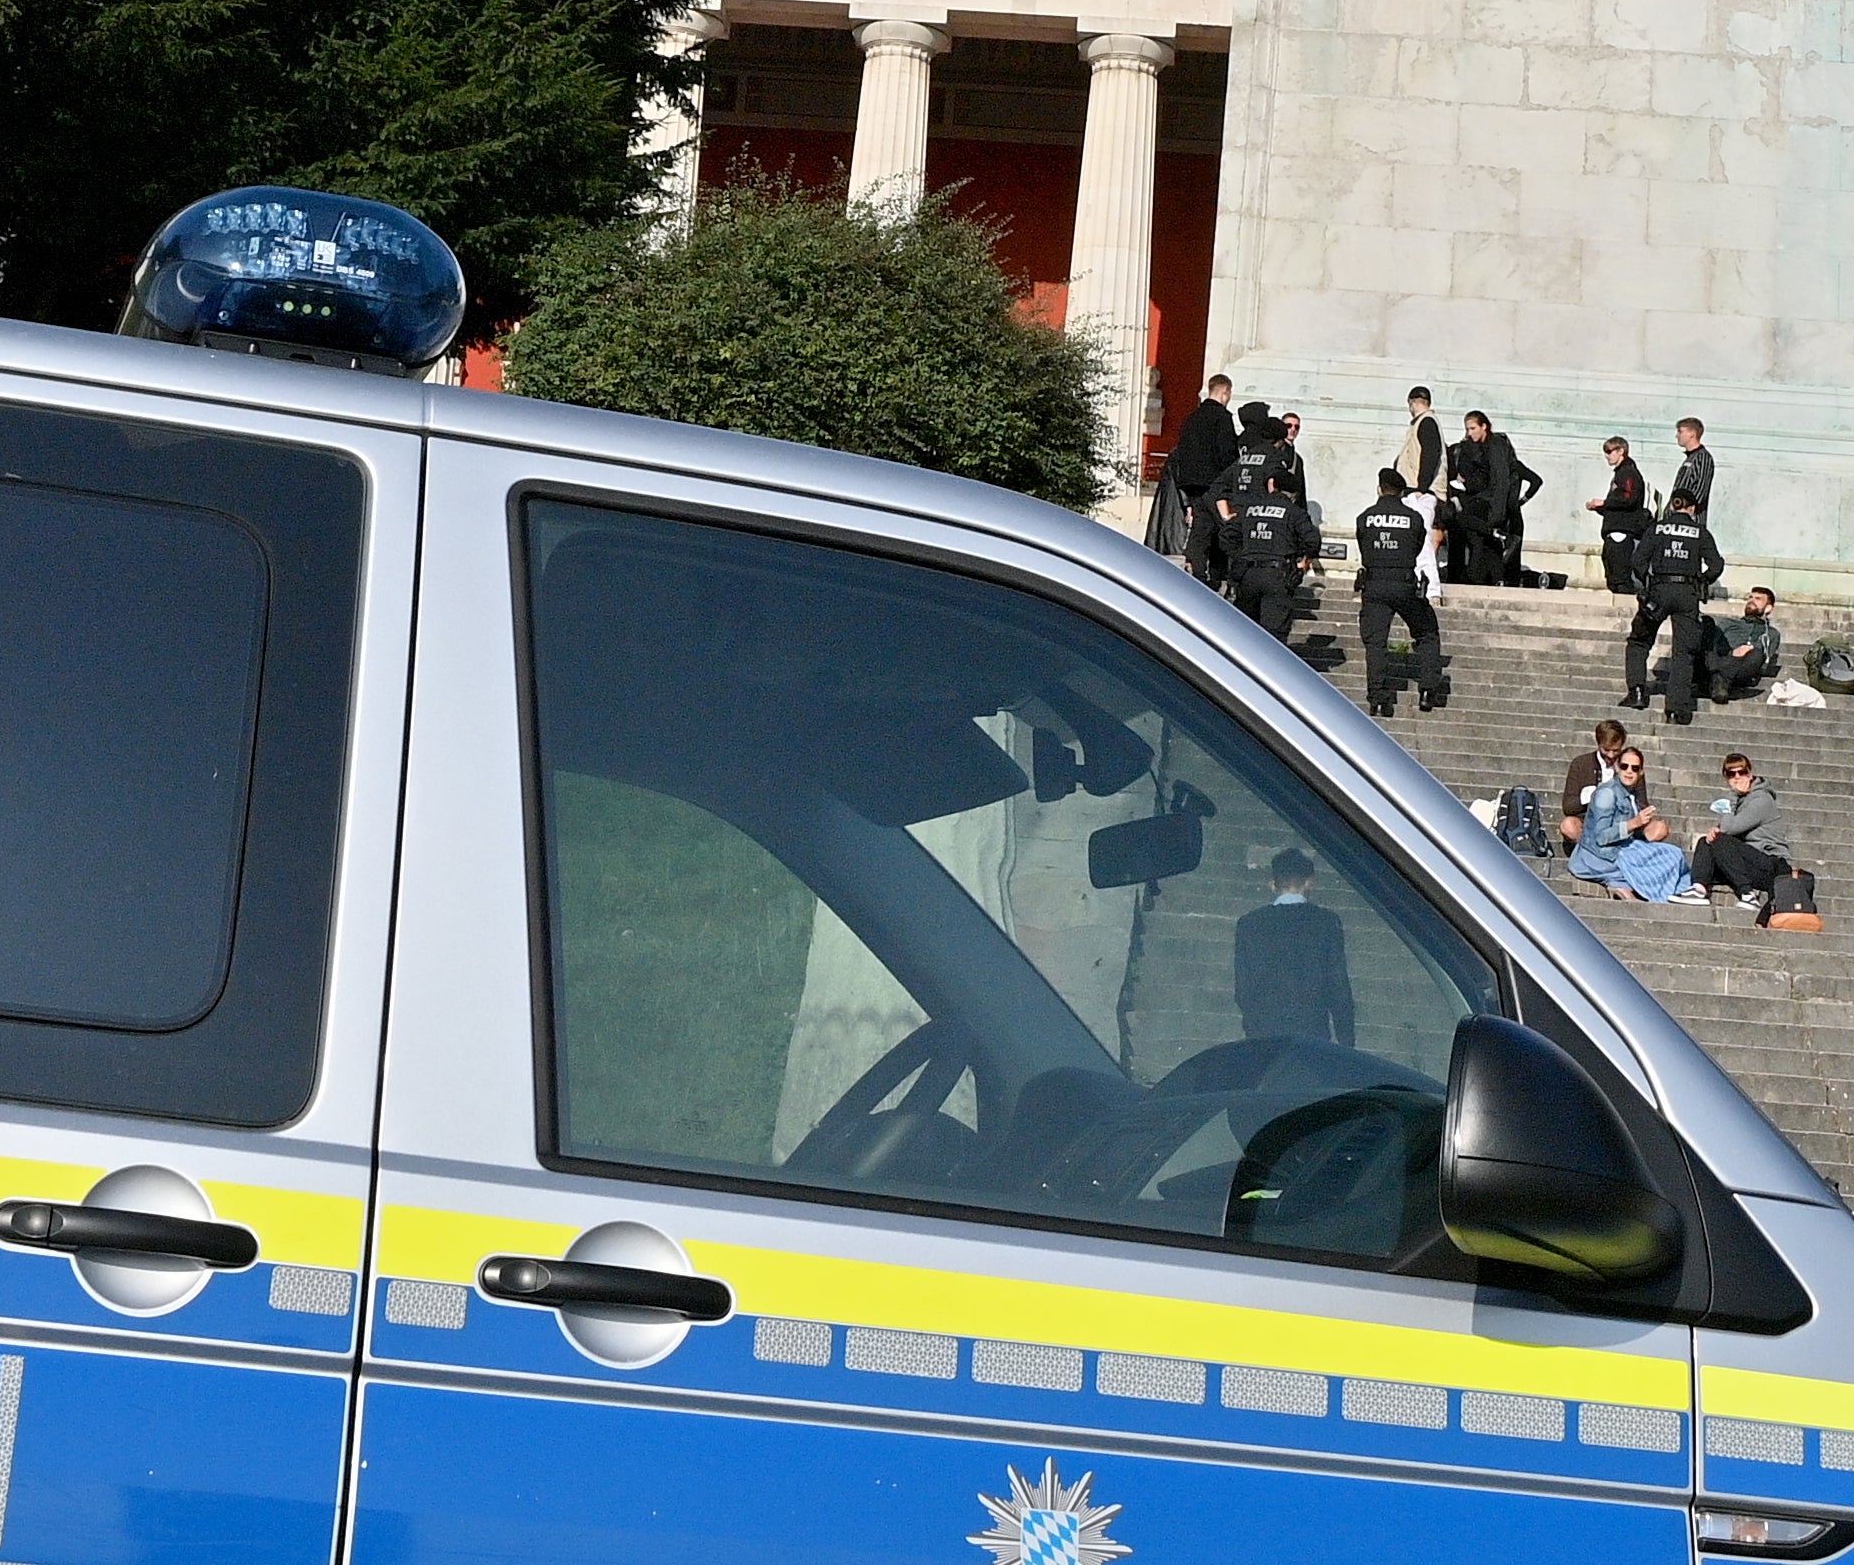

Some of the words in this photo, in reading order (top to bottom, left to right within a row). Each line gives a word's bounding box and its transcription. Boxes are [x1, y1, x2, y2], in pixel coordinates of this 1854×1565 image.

[1246, 505, 1286, 518] POLIZEI
[1366, 514, 1411, 528] POLIZEI
[1379, 531, 1391, 541] BY
[1655, 524, 1699, 538] POLIZEI
[1671, 541, 1683, 550] BY
